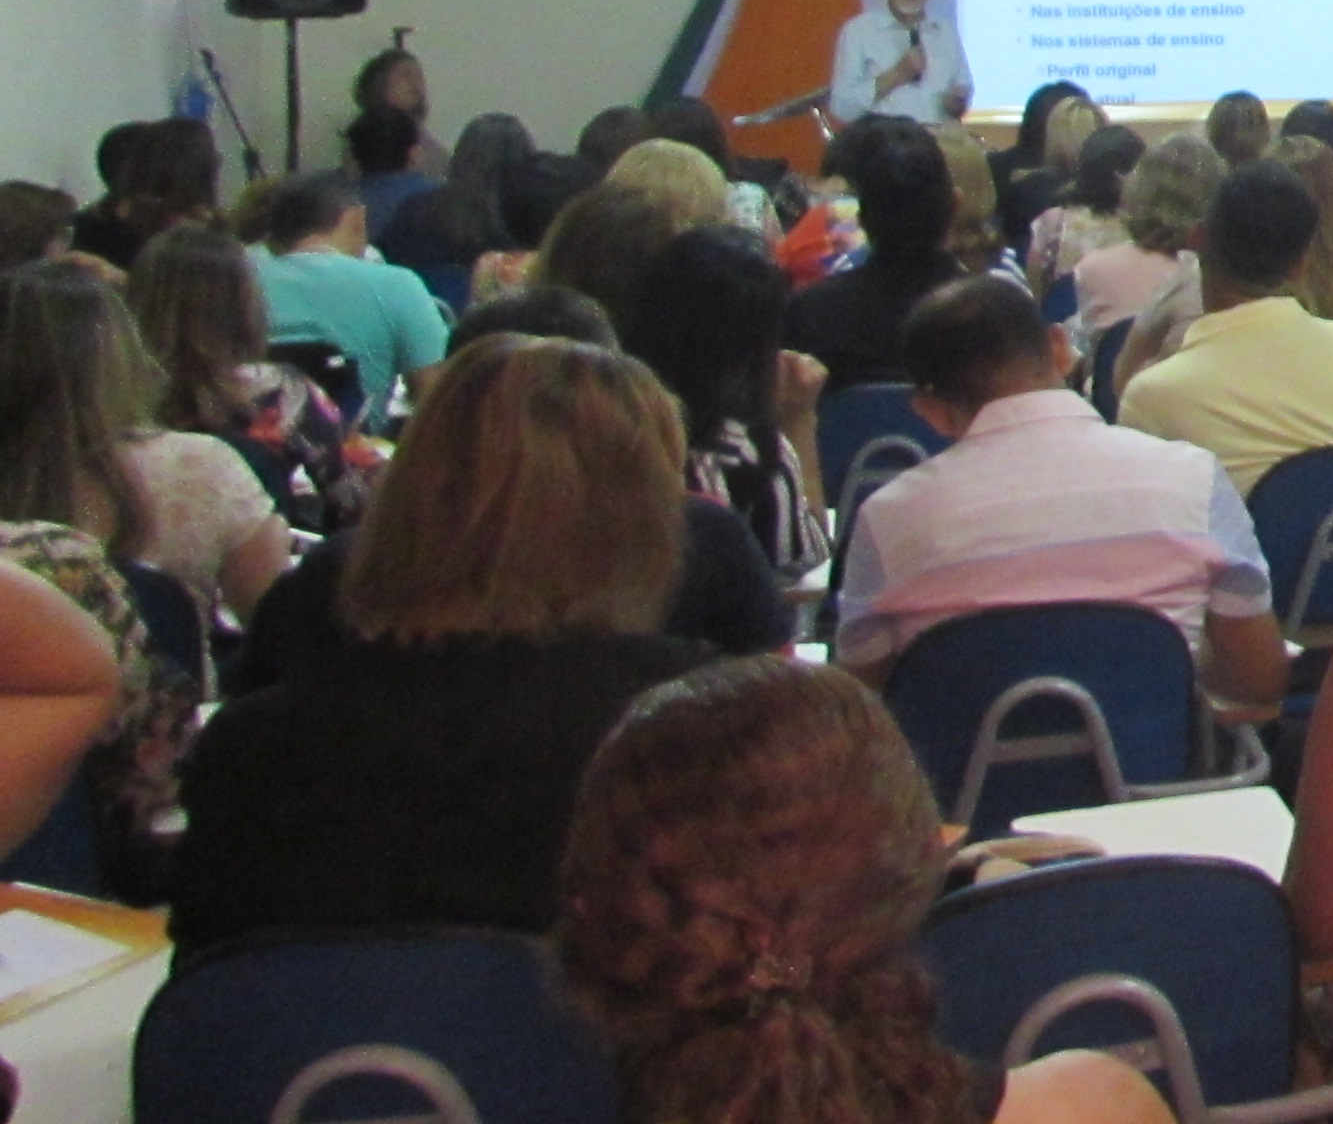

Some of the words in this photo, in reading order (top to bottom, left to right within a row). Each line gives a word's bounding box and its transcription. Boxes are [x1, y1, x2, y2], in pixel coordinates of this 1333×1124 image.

[1030, 4, 1064, 19] Nas
[1066, 3, 1163, 21] instituições
[1165, 3, 1188, 18] de
[1189, 3, 1246, 17] ensino
[1030, 34, 1065, 49] Nos
[1067, 34, 1143, 48] sistemas
[1145, 32, 1168, 47] de
[1169, 33, 1226, 47] ensino
[1046, 63, 1091, 80] Perfil
[1094, 63, 1157, 80] original
